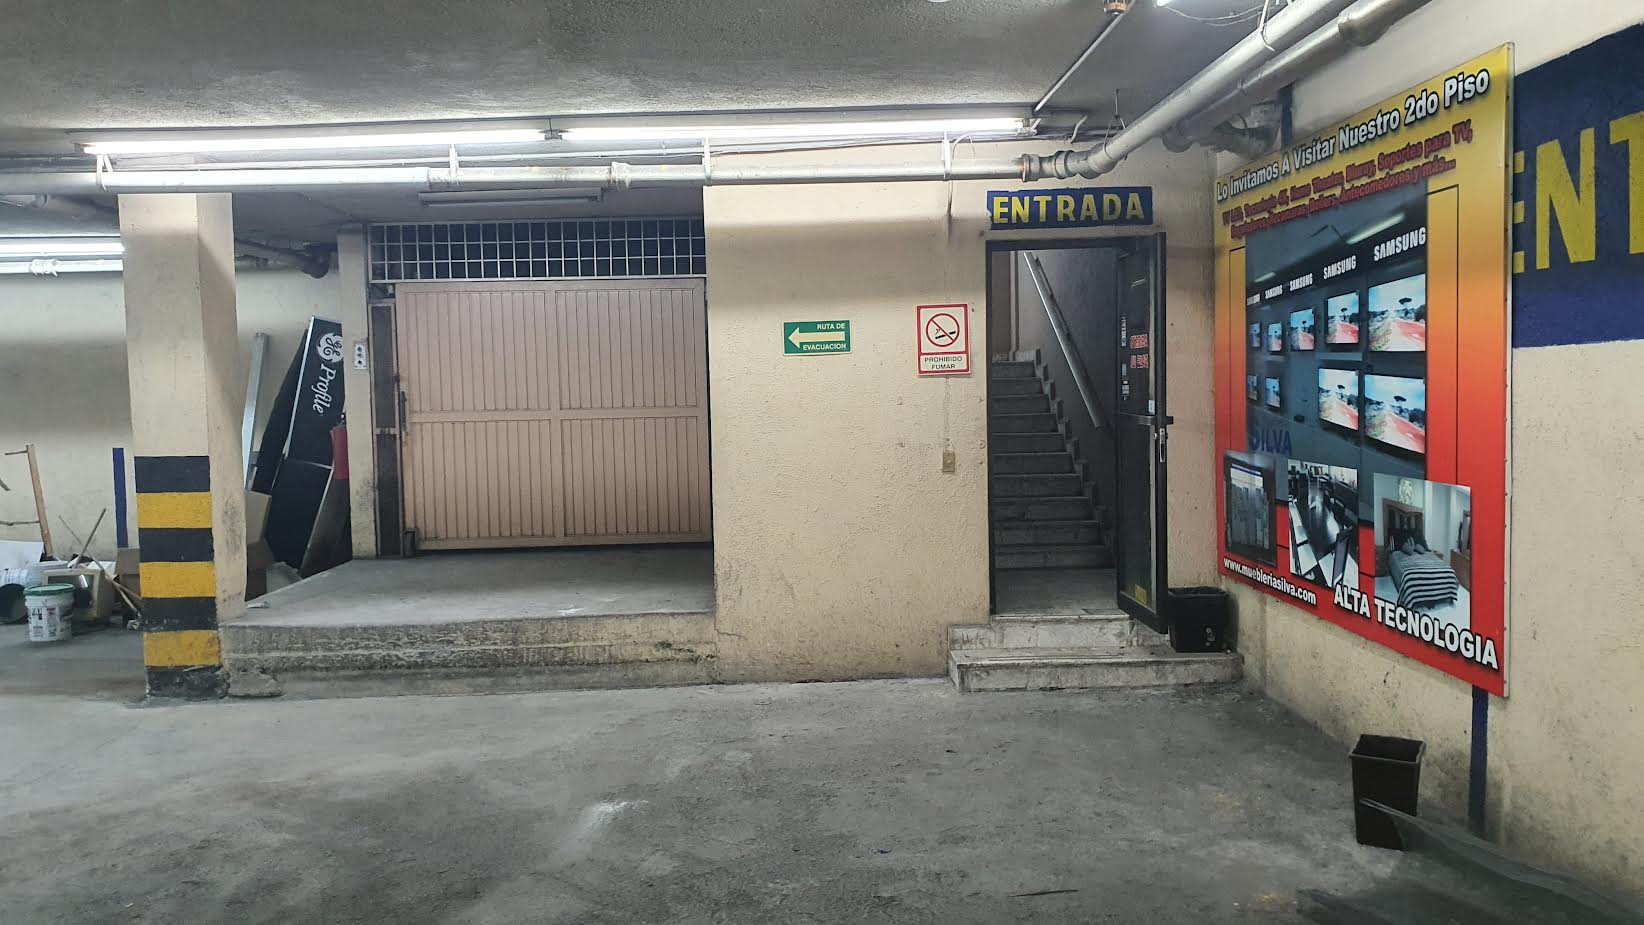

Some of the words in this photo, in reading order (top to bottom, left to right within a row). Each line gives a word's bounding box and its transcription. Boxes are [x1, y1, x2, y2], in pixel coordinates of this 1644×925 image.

[1217, 182, 1229, 203] Lo
[1230, 161, 1279, 196] Invitamos
[1281, 150, 1291, 175] A
[1293, 136, 1337, 170] Visitar
[1339, 108, 1400, 154] Nuestro
[1404, 89, 1439, 126] 2do
[1444, 68, 1490, 109] Piso
[1378, 142, 1423, 171] Soportes
[1424, 131, 1451, 158] para
[1452, 118, 1473, 144] TV,
[1341, 167, 1413, 205] Antecomedores
[1413, 164, 1421, 184] y
[993, 192, 1145, 224] ENTRADA
[1374, 226, 1427, 262] SAMSUNG
[1289, 273, 1313, 292] SAMSUNG
[1323, 255, 1357, 280] SAMSUNG
[816, 323, 835, 331] RUTA
[836, 322, 846, 330] DE
[802, 343, 847, 351] EVACUACION
[924, 355, 963, 363] PROHIBIDO
[311, 362, 337, 414] Profile
[1223, 557, 1317, 606] www.muebleriasilva.com
[1333, 583, 1371, 618] ALTA
[1373, 597, 1499, 670] TECNOLOGIA
